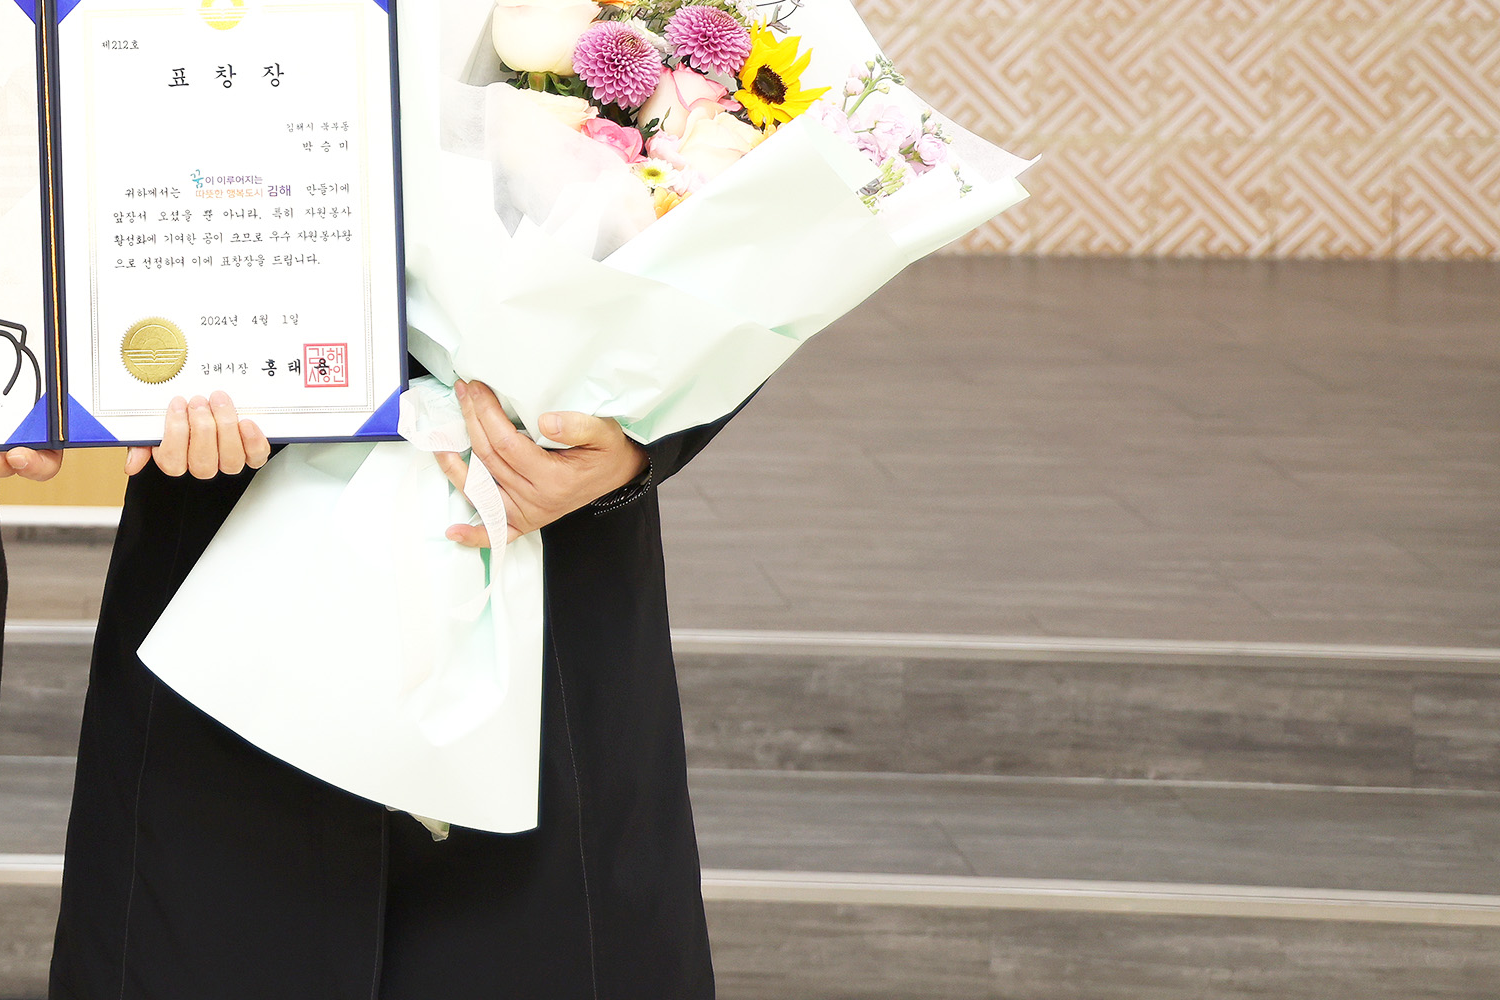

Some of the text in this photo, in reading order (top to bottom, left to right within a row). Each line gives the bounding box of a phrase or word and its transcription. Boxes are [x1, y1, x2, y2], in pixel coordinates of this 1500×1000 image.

[102, 40, 139, 49] 제212호
[287, 123, 313, 132] 김해시
[217, 176, 262, 185] 이루어지는
[196, 190, 223, 198] 따뜻한
[226, 187, 264, 199] 행복도시
[268, 185, 291, 197] 김해
[306, 183, 349, 196] 만들기에
[114, 211, 146, 223] 앞장서
[272, 208, 293, 219] 특히
[306, 206, 351, 219] 자원봉사
[164, 233, 196, 245] 기여한
[203, 232, 222, 244] 공이
[230, 233, 263, 242] 크므로
[269, 231, 290, 242] 우수
[298, 230, 352, 242] 자원봉사왕
[115, 254, 320, 269] 으로 선정하여 이에 표창장을 드립니다.
[201, 314, 298, 326] 2024년 4월 1일
[201, 363, 248, 375] 김해시장
